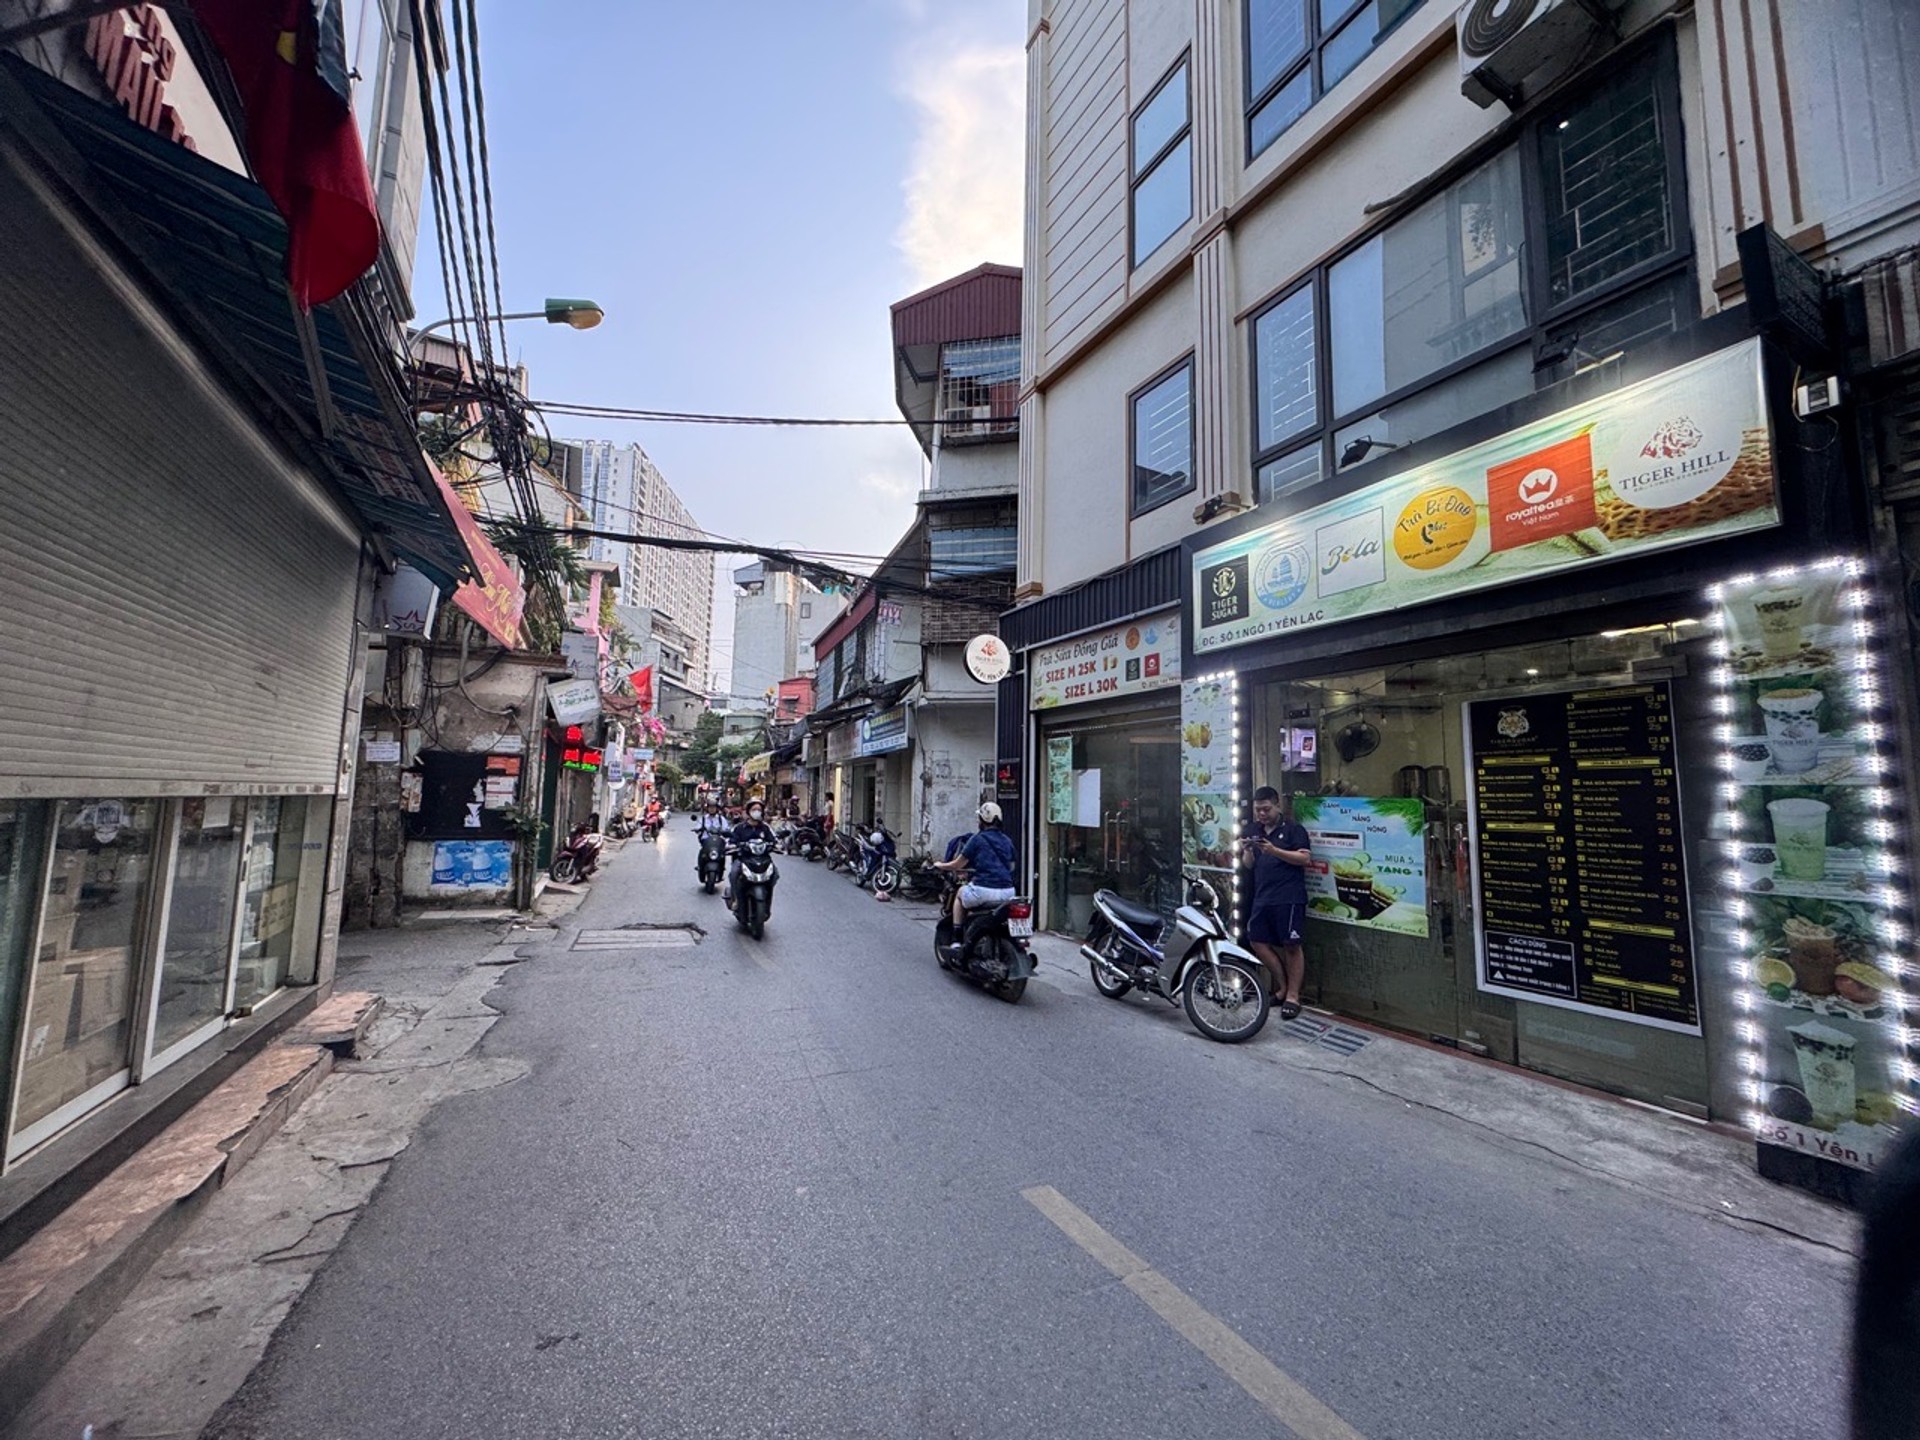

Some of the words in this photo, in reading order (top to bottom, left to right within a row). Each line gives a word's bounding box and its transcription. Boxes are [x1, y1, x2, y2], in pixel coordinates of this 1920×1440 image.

[1619, 466, 1675, 490] TIGER
[1681, 450, 1730, 473] HILL
[1539, 510, 1559, 521] Nam
[1211, 595, 1238, 610] TIGER
[1211, 606, 1238, 621] SUGAR
[1268, 621, 1273, 631] 1
[1275, 616, 1297, 630] YÊN
[1300, 610, 1325, 625] LẠC
[1046, 668, 1065, 683] SIZE
[1067, 665, 1076, 678] M
[1078, 660, 1097, 675] 25K
[1065, 683, 1086, 699] SIZE
[1088, 681, 1094, 695] L
[1097, 677, 1118, 693] 30K
[1654, 778, 1668, 786] 25
[1656, 796, 1670, 805] 25
[1656, 813, 1671, 821] 25
[1657, 827, 1673, 835] 25
[1659, 844, 1674, 853] 25
[1384, 854, 1405, 863] MUA
[1408, 856, 1414, 864] 5
[1662, 862, 1677, 871] 25
[1662, 877, 1677, 886] 25
[1663, 895, 1679, 904] 25
[1665, 911, 1680, 920] 25
[1669, 943, 1684, 953] 25
[1670, 958, 1684, 968] 25
[1671, 973, 1686, 984] 25
[1760, 1123, 1788, 1141] Số
[1795, 1132, 1805, 1145] 1
[1814, 1137, 1859, 1162] Yên
